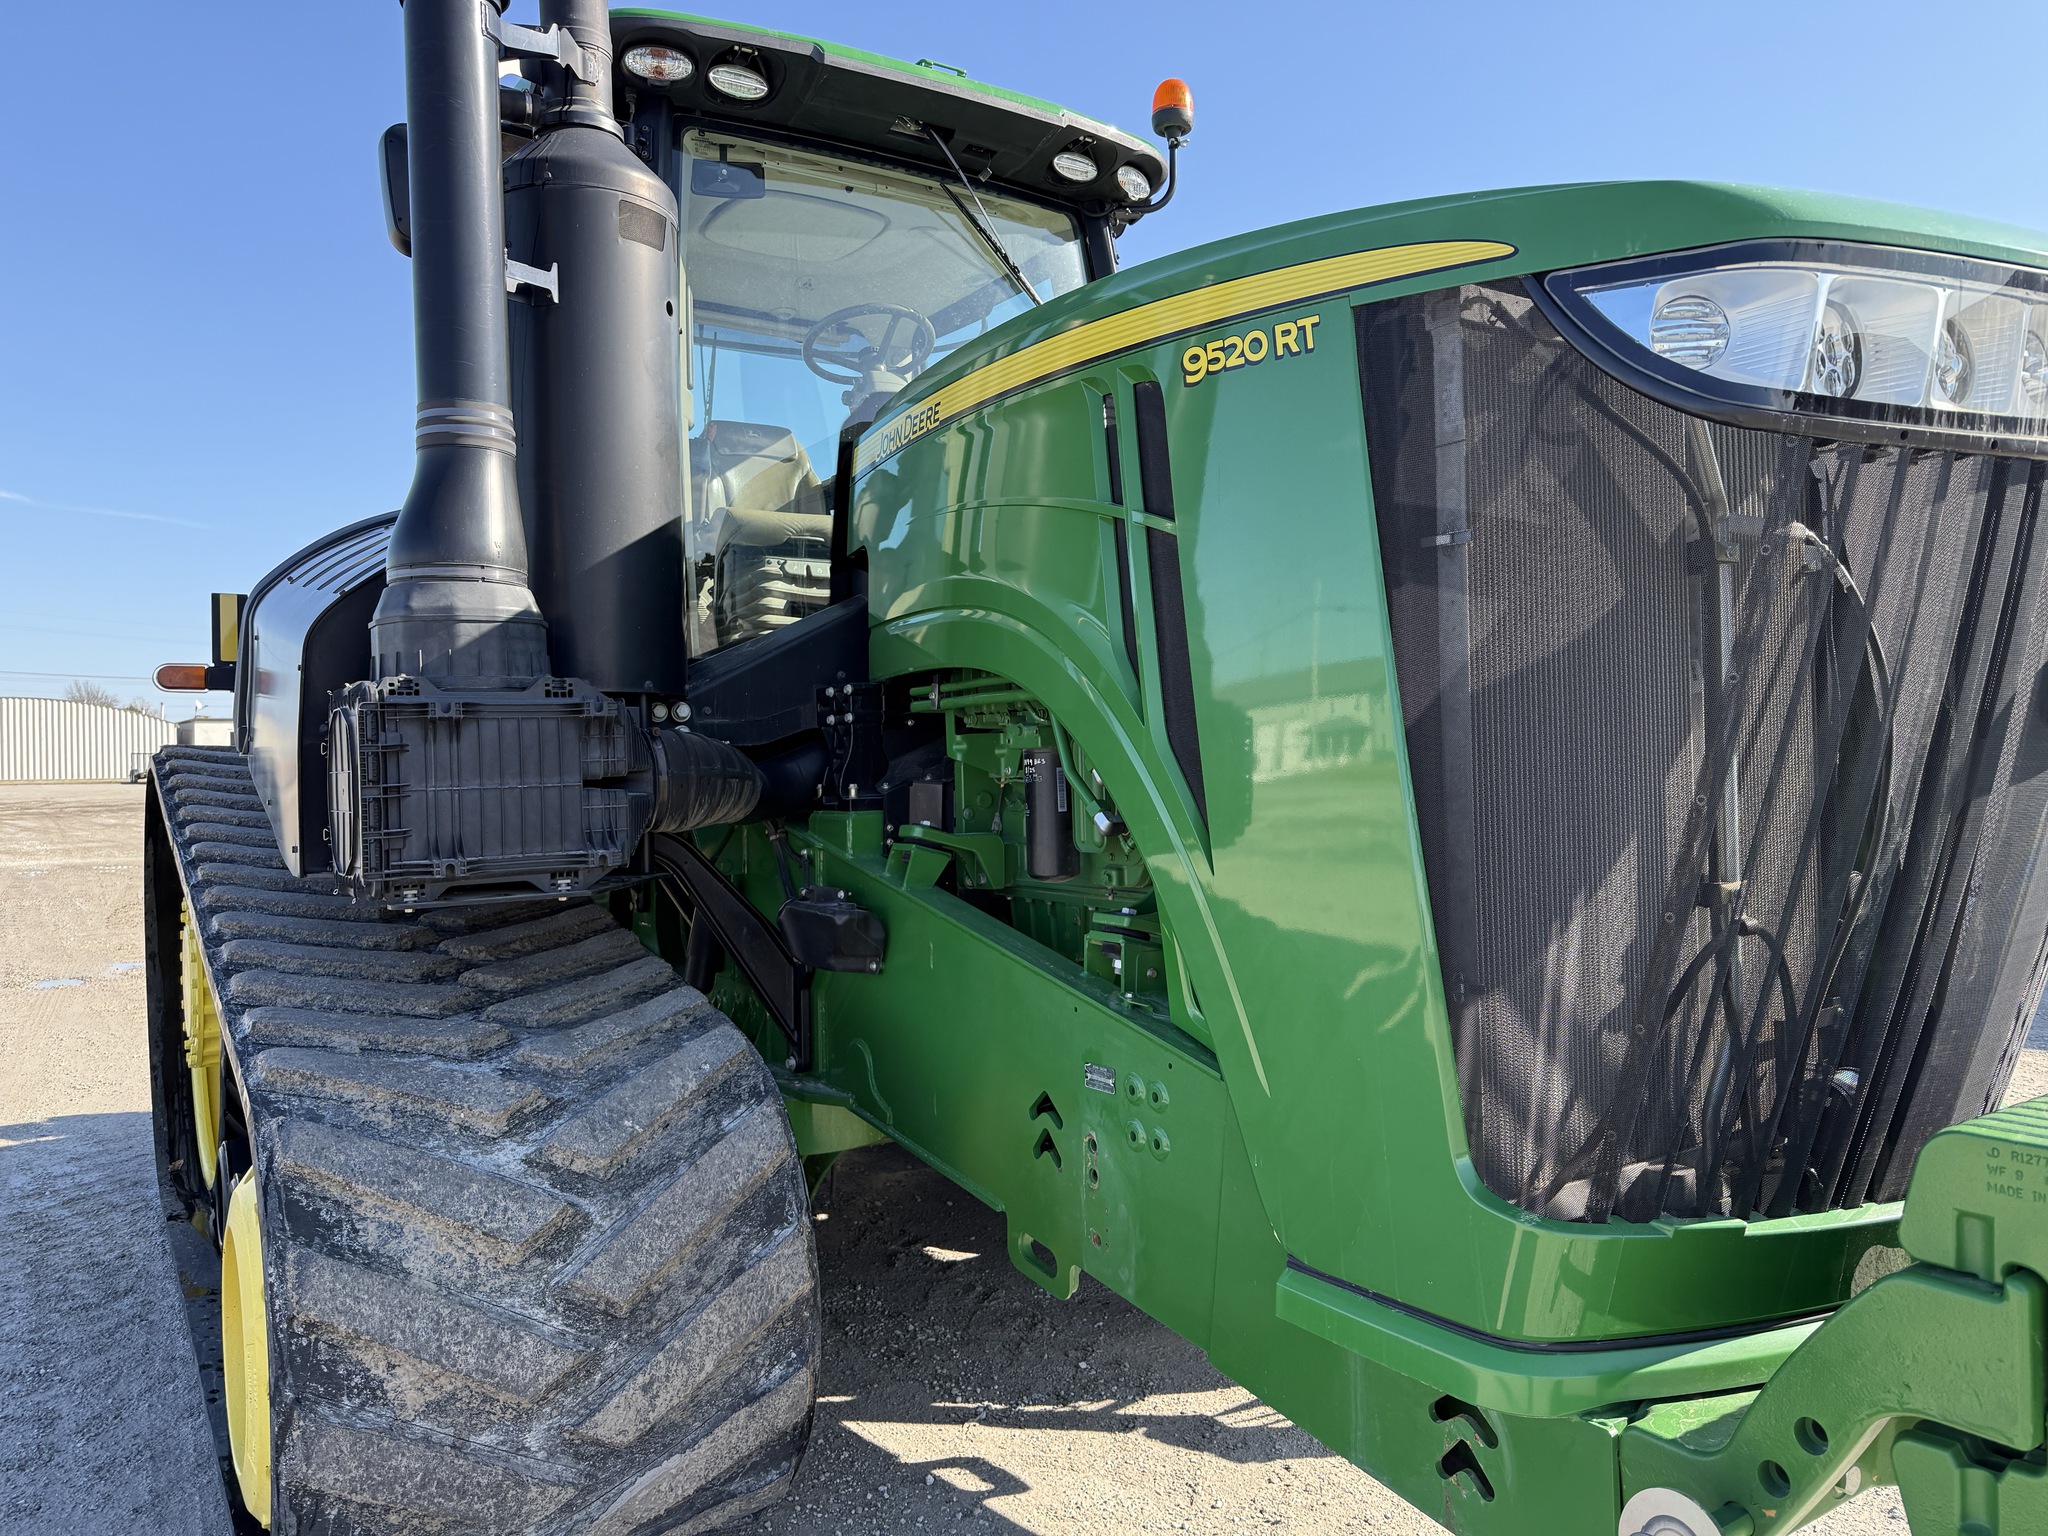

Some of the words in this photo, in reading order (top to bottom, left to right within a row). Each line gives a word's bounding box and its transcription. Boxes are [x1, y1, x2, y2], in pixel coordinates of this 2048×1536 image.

[1181, 328, 1269, 388] 9520
[1272, 314, 1320, 361] RT
[876, 423, 903, 460] JOHN
[903, 401, 942, 441] DEERE
[1986, 1146, 2000, 1159] JD
[1986, 1163, 2006, 1176] WF
[1986, 1181, 2024, 1199] MADE
[2032, 1190, 2047, 1203] IN
